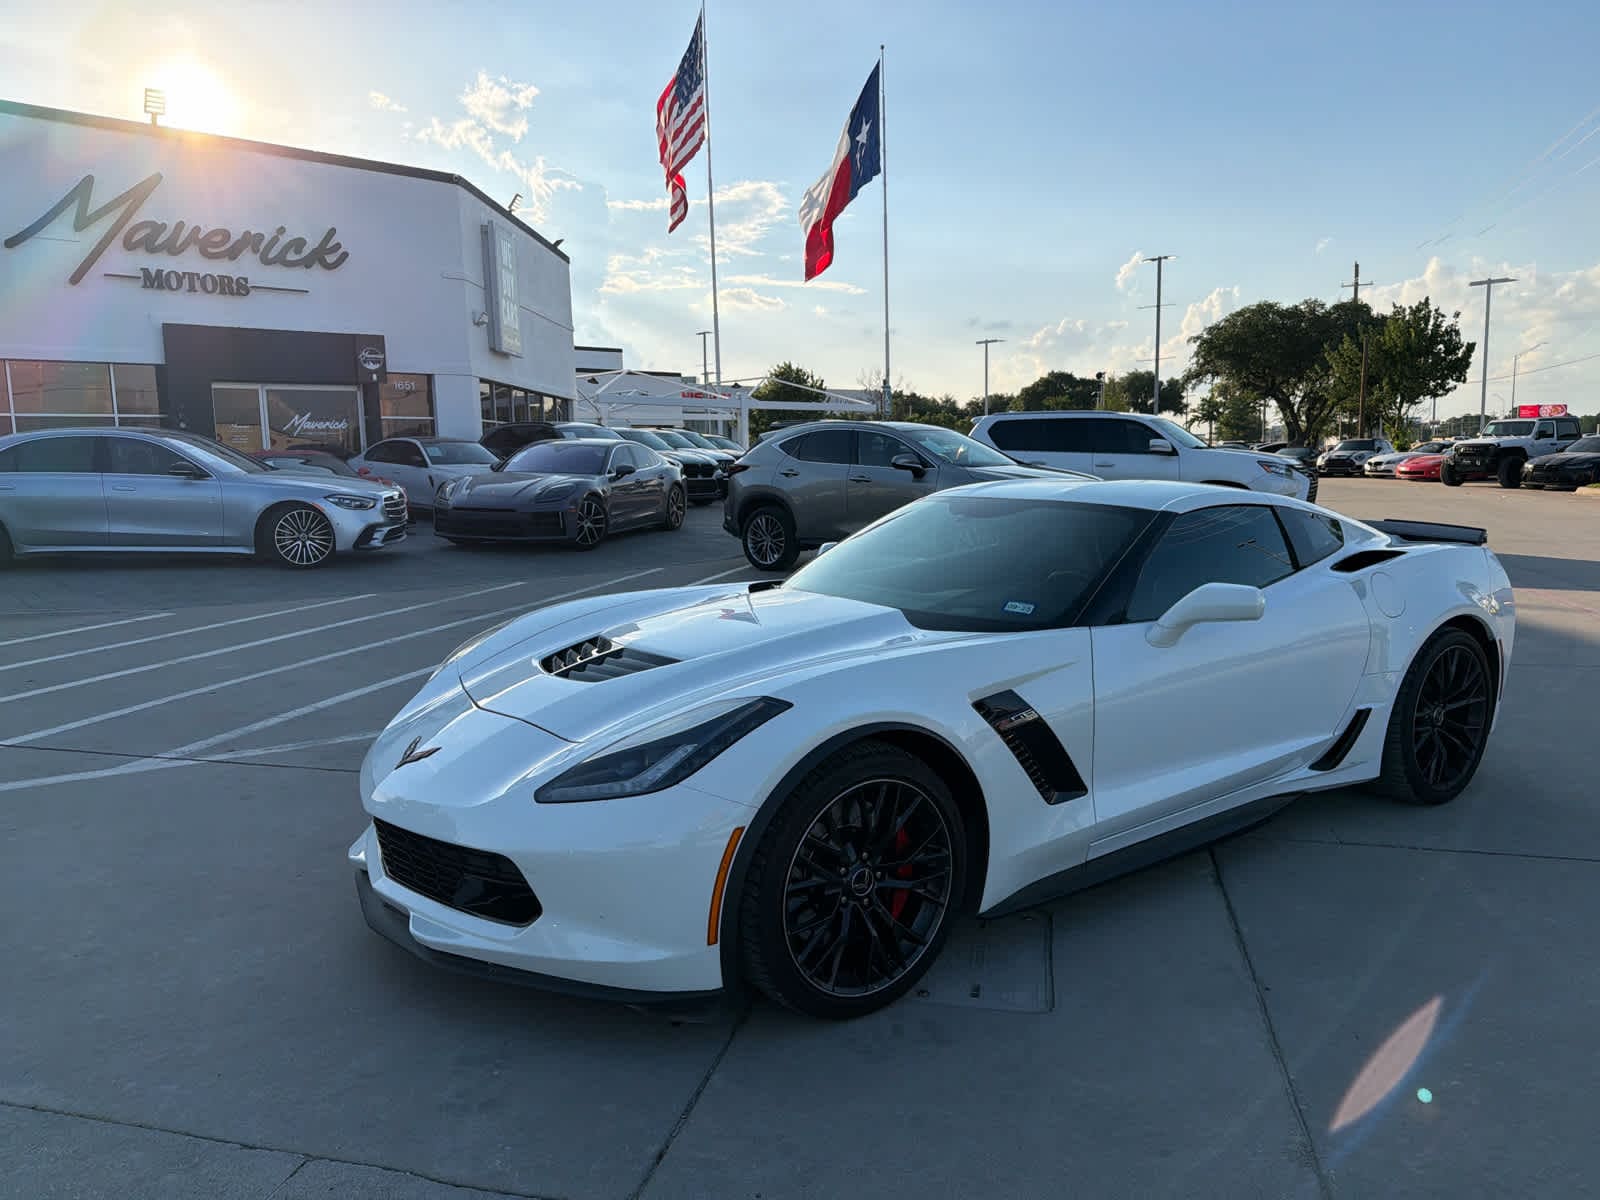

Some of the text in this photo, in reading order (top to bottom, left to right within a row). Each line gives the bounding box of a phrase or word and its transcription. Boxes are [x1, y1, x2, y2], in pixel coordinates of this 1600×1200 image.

[4, 172, 349, 286] Maverick
[140, 267, 250, 297] MOTORS
[393, 382, 416, 391] 1651
[282, 412, 348, 437] Maverick
